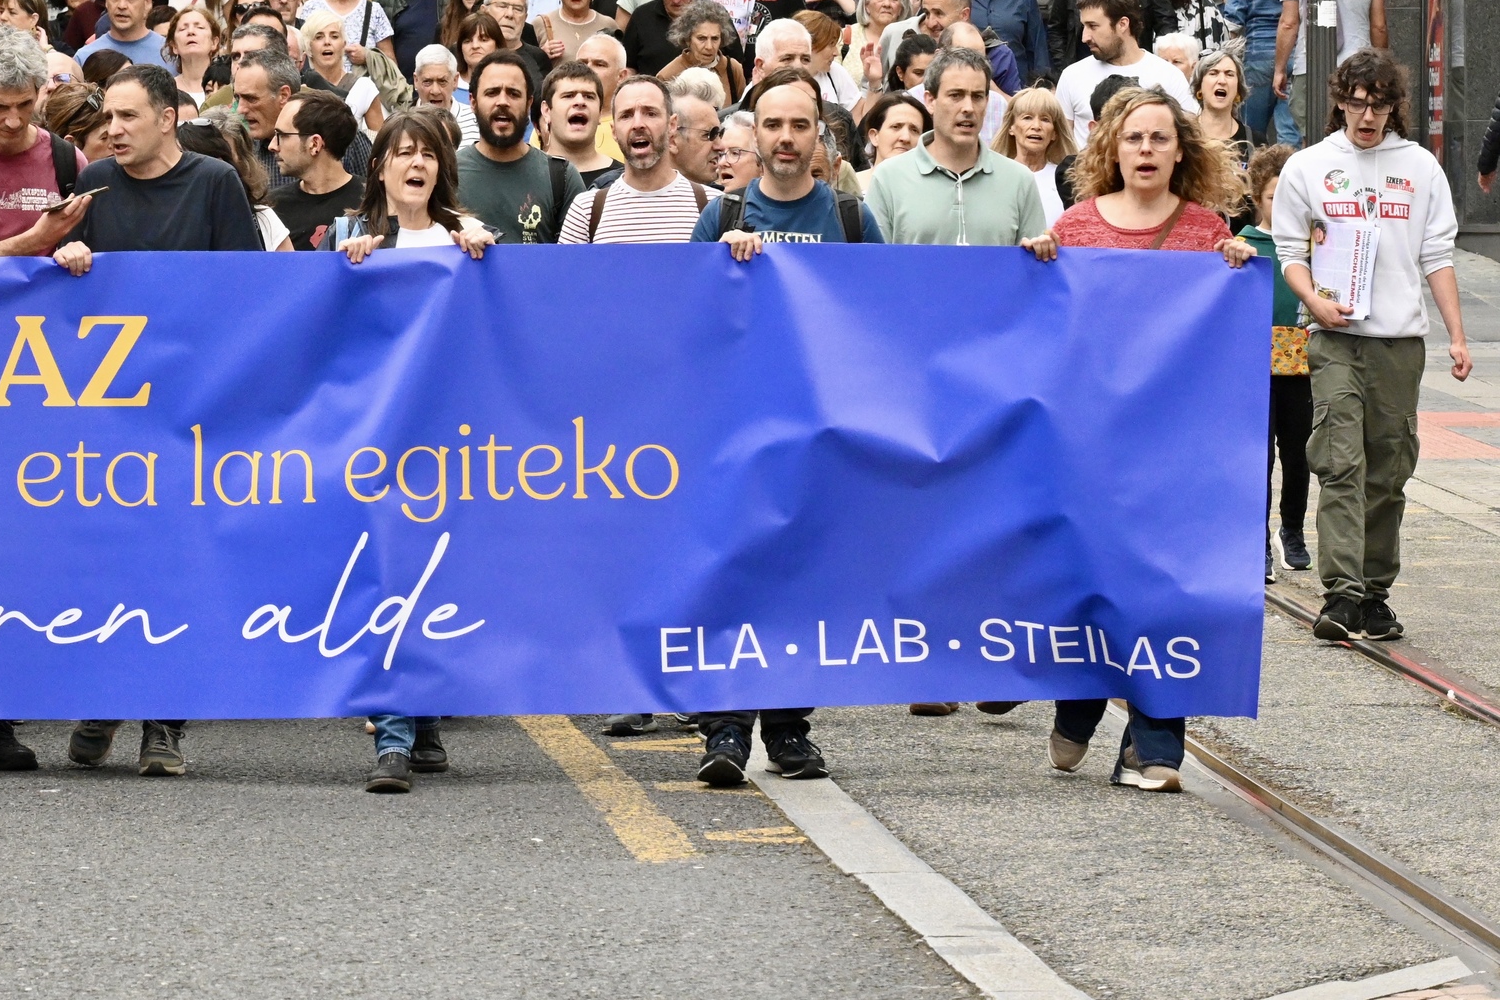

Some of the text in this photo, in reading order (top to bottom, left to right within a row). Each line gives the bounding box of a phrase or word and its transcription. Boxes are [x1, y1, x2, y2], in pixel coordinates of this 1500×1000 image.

[1325, 203, 1409, 217] RIVER PLATE
[1351, 249, 1359, 274] LUCHA
[17, 440, 159, 508] eta
[190, 423, 317, 507] lan
[344, 415, 680, 523] egiteko
[241, 530, 486, 671] alde
[660, 618, 1201, 679] ELA LAB STEILAS
